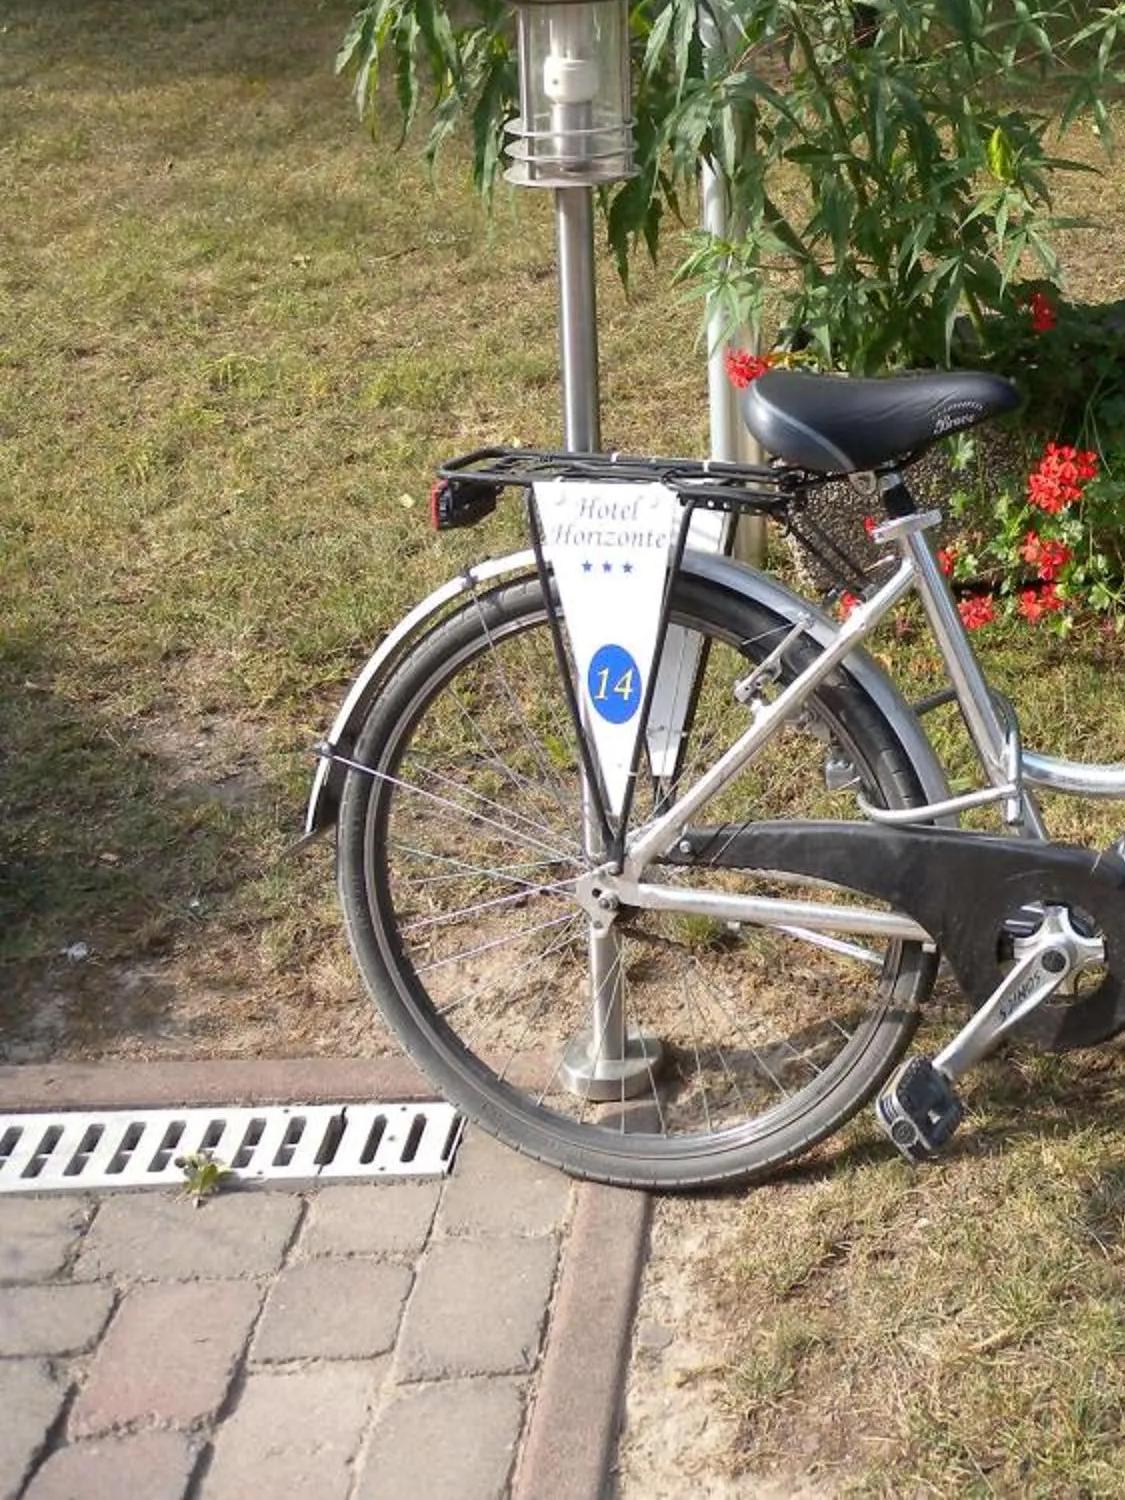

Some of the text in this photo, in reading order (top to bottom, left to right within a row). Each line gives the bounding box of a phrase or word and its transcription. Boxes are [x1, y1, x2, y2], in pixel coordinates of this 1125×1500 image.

[578, 494, 645, 521] Hotel
[553, 521, 667, 549] Horizonte
[593, 666, 634, 702] 14
